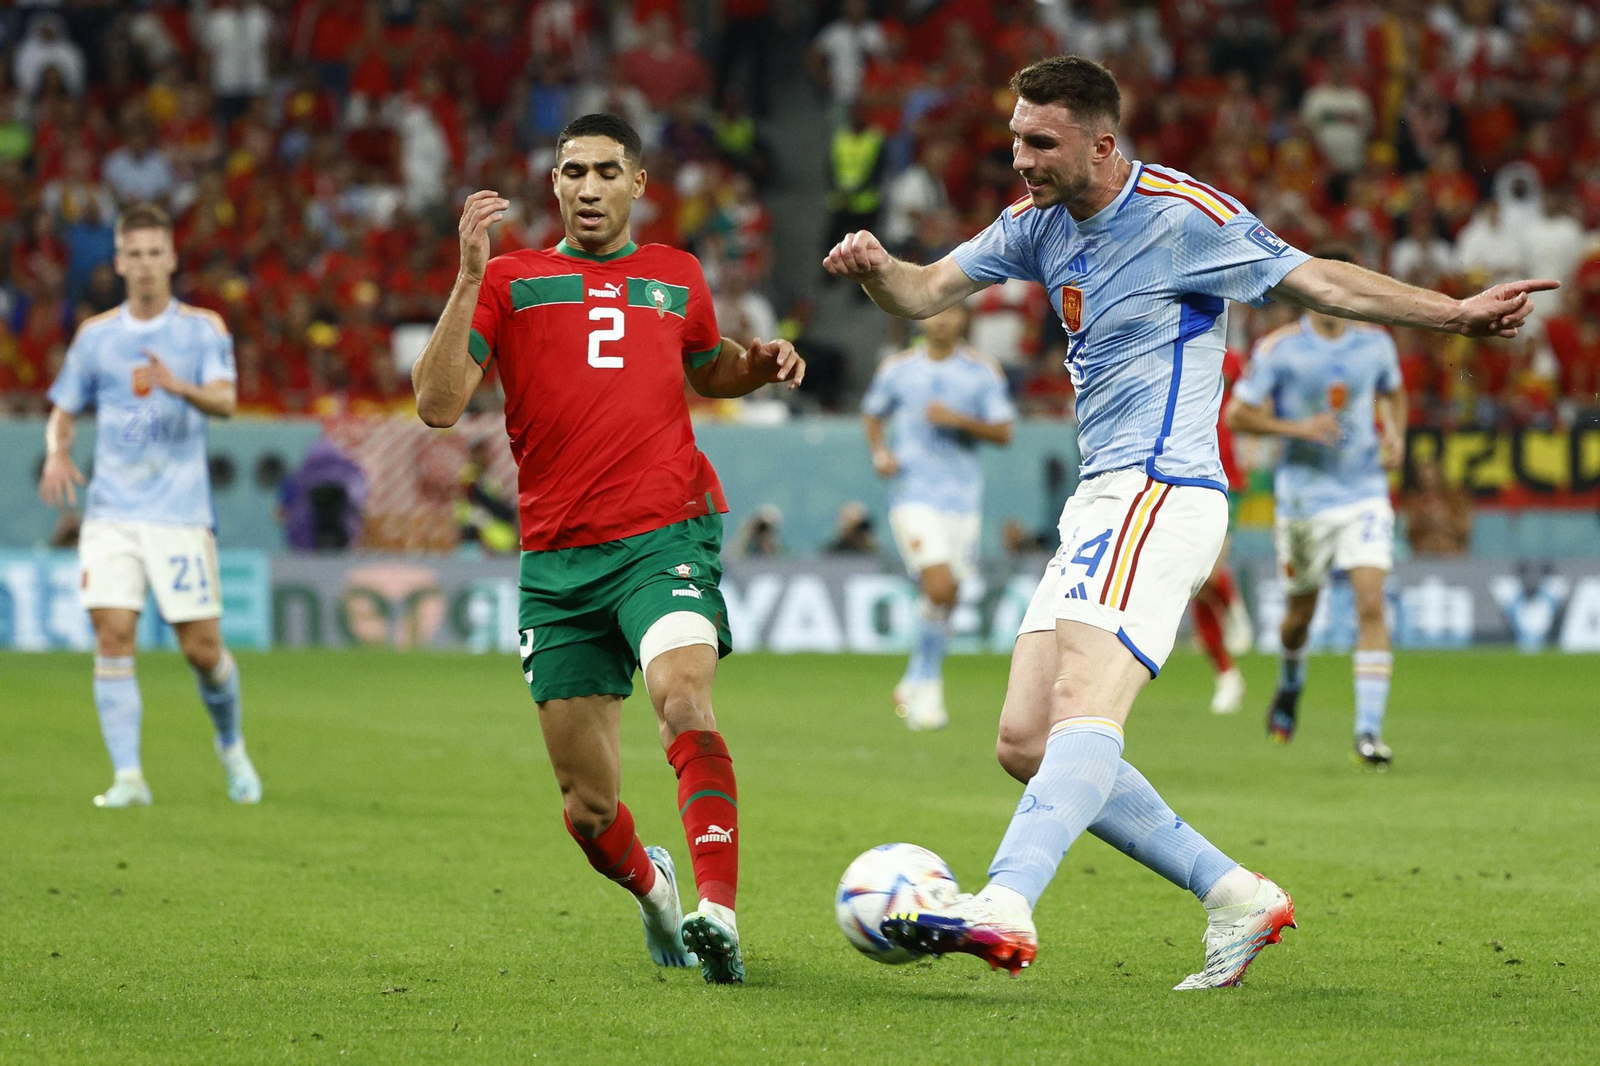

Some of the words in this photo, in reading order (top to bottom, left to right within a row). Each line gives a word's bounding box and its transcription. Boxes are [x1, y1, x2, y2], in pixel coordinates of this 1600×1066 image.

[588, 287, 617, 299] PUMA
[587, 306, 625, 368] 2
[1061, 528, 1113, 578] 4
[169, 554, 207, 591] 21
[672, 588, 700, 599] PUMA
[695, 833, 727, 846] PUMA
